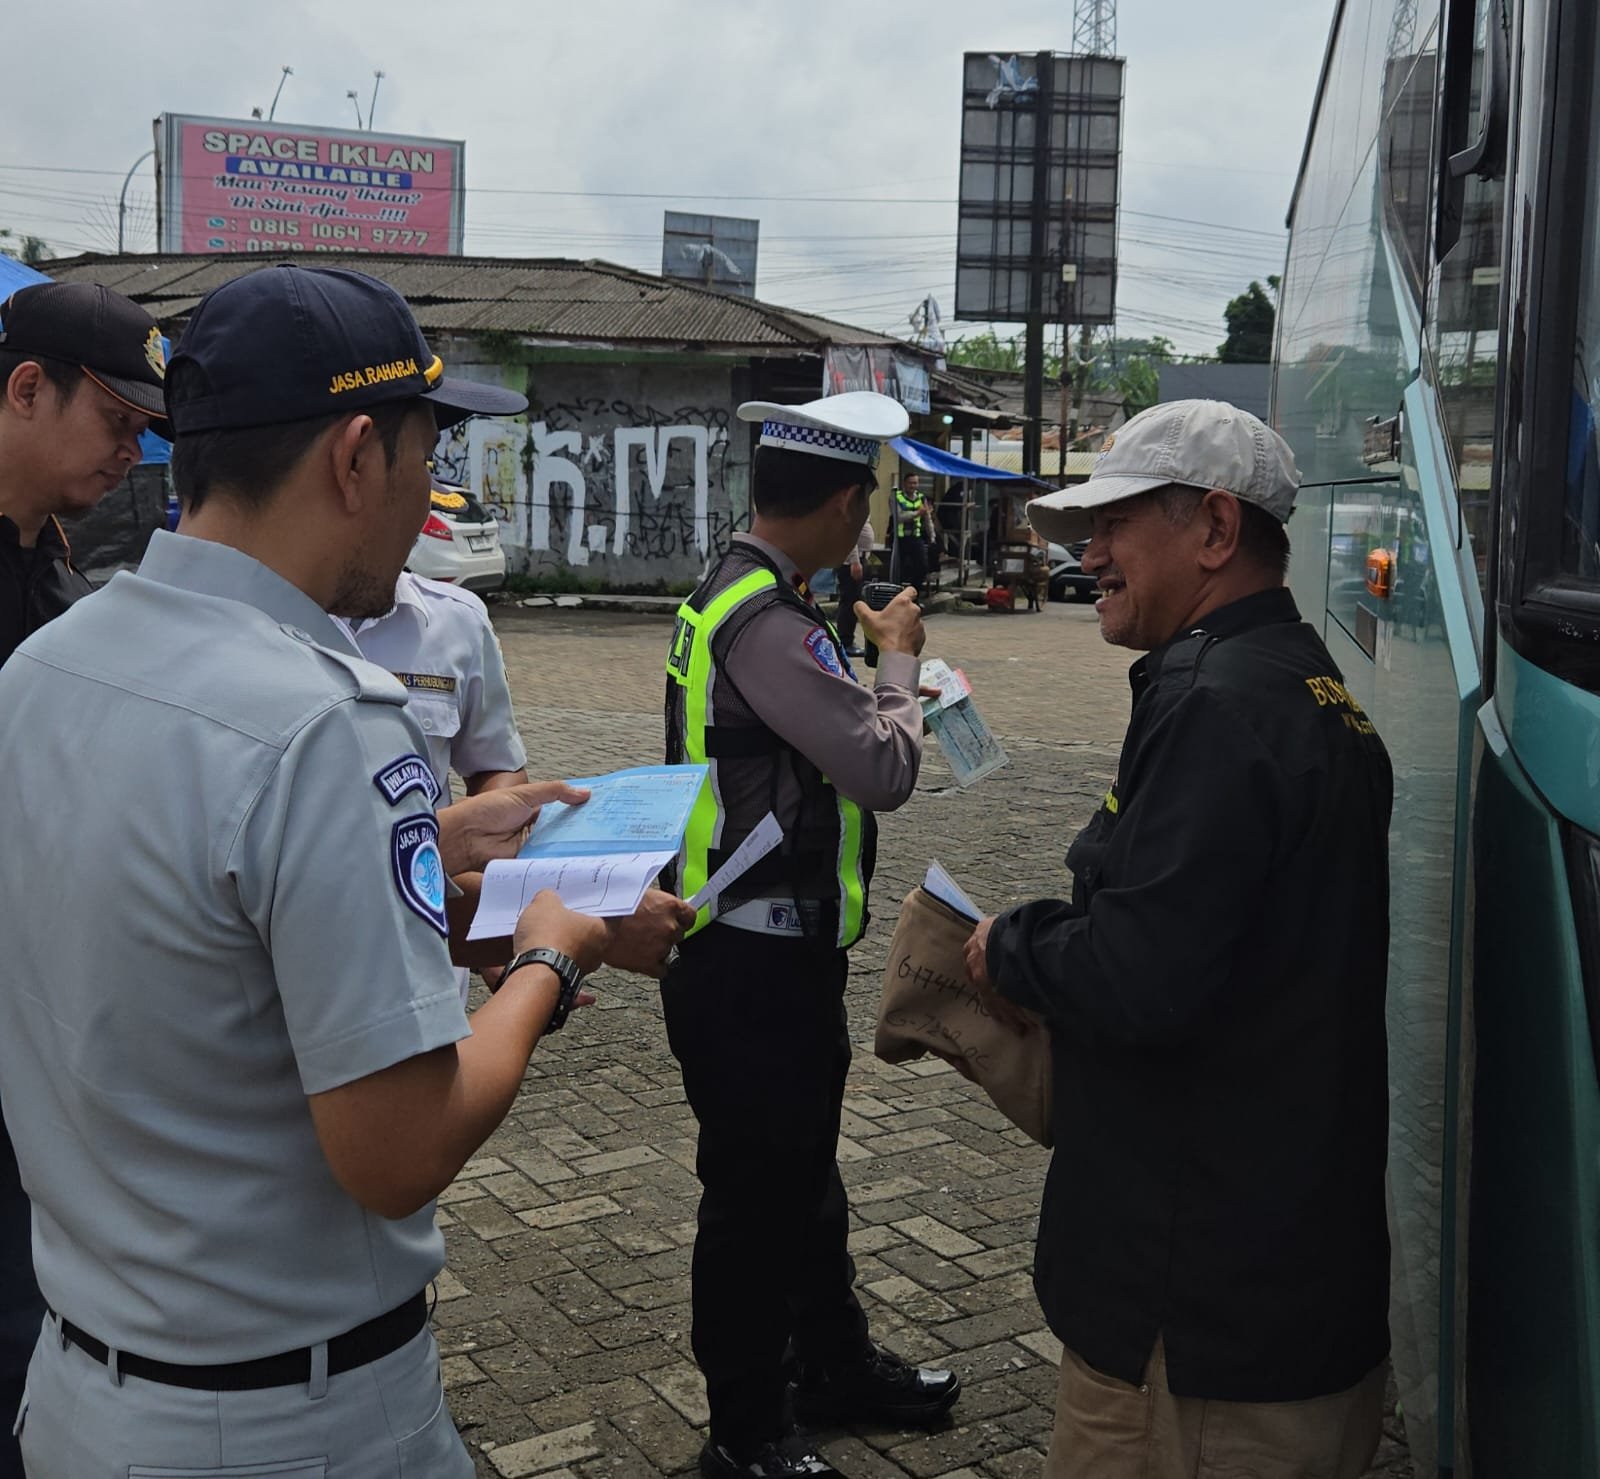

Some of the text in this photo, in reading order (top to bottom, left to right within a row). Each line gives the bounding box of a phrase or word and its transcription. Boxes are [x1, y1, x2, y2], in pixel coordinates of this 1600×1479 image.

[203, 131, 434, 174] SPACE IKLAN
[238, 160, 402, 187] AVAILABLE
[215, 175, 422, 205] Mau Pasang Iklan?
[229, 195, 255, 208] Di
[261, 197, 304, 213] Sini
[249, 218, 300, 236] 0815
[312, 223, 360, 241] 1064
[372, 228, 429, 247] 9777
[329, 357, 419, 394] JASA RAHARJA
[399, 827, 420, 850] JASA
